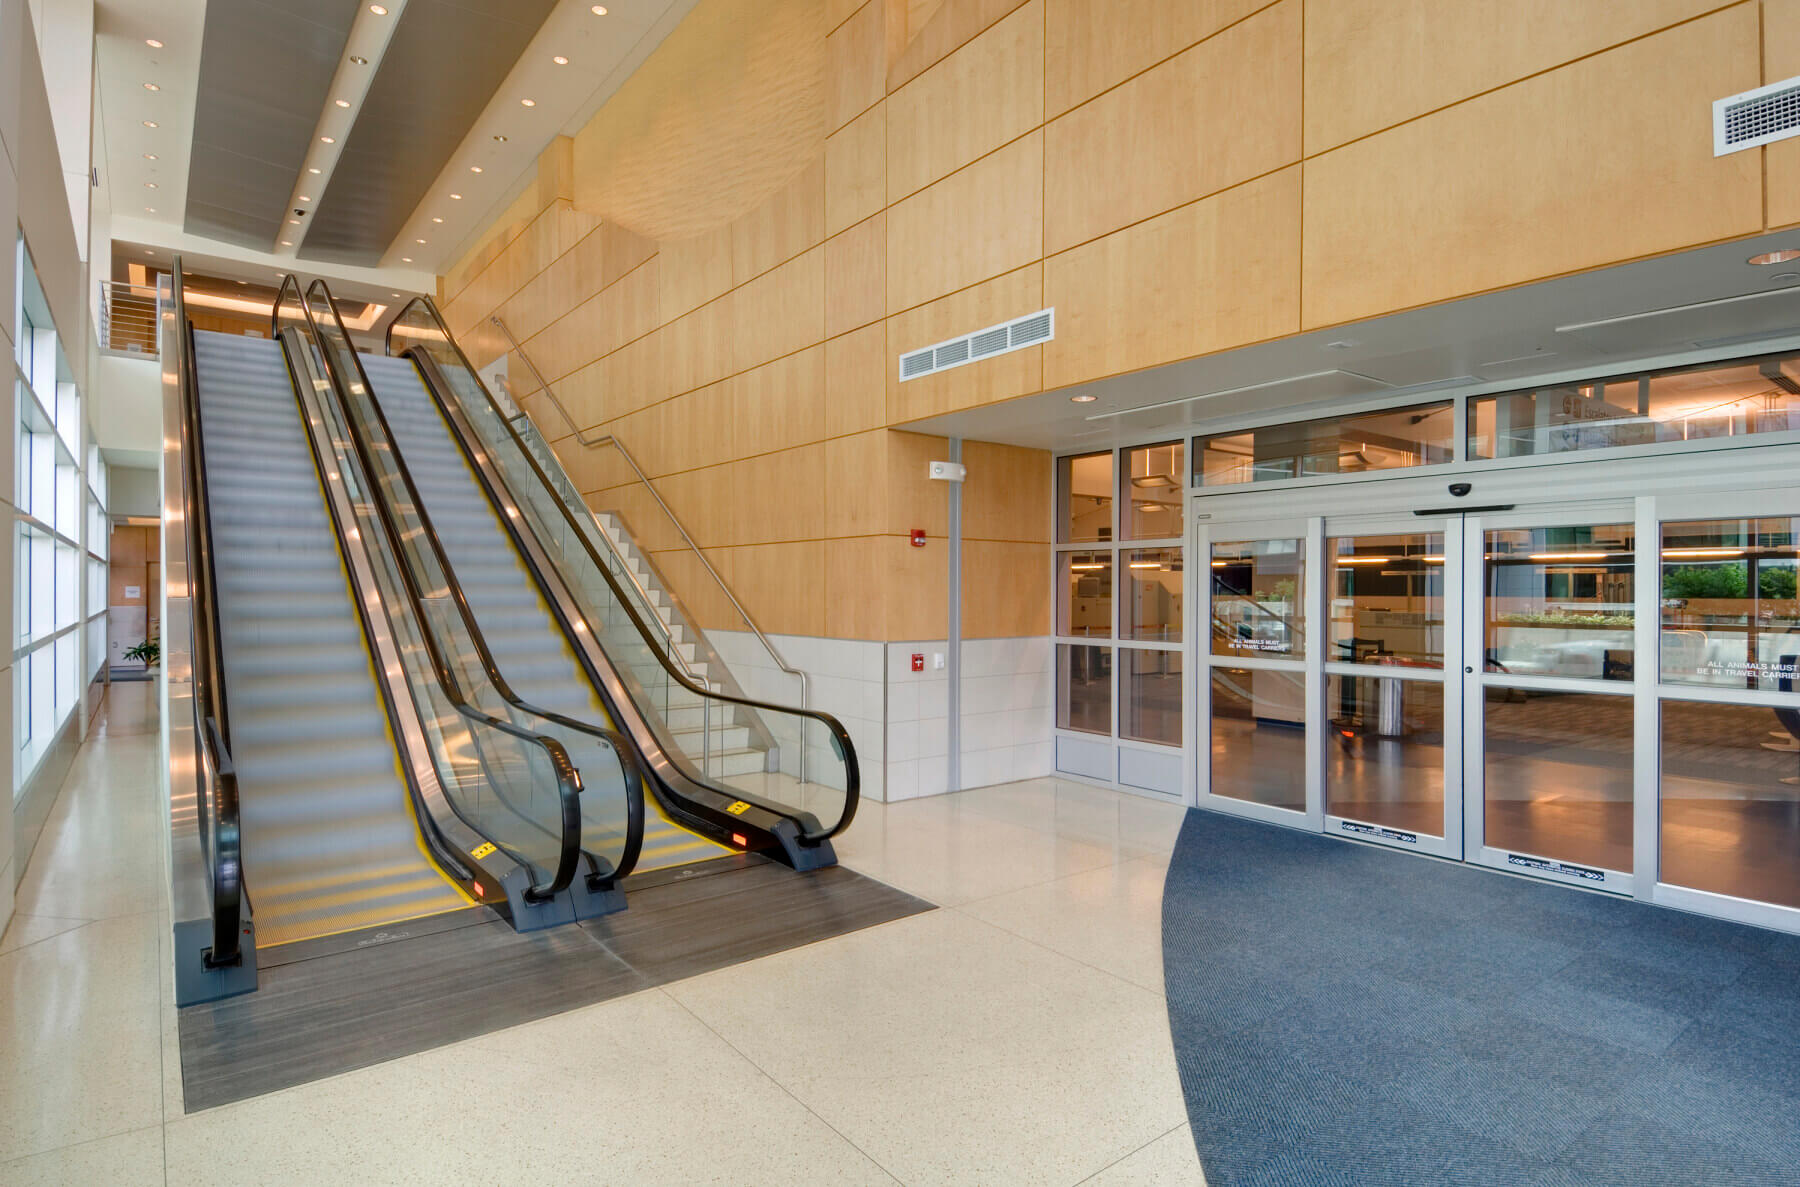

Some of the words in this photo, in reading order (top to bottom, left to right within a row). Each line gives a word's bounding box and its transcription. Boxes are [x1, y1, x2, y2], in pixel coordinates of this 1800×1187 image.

[1727, 661, 1767, 670] ANIMALS
[1696, 667, 1709, 675] BE
[1725, 669, 1758, 678] TRAVEL
